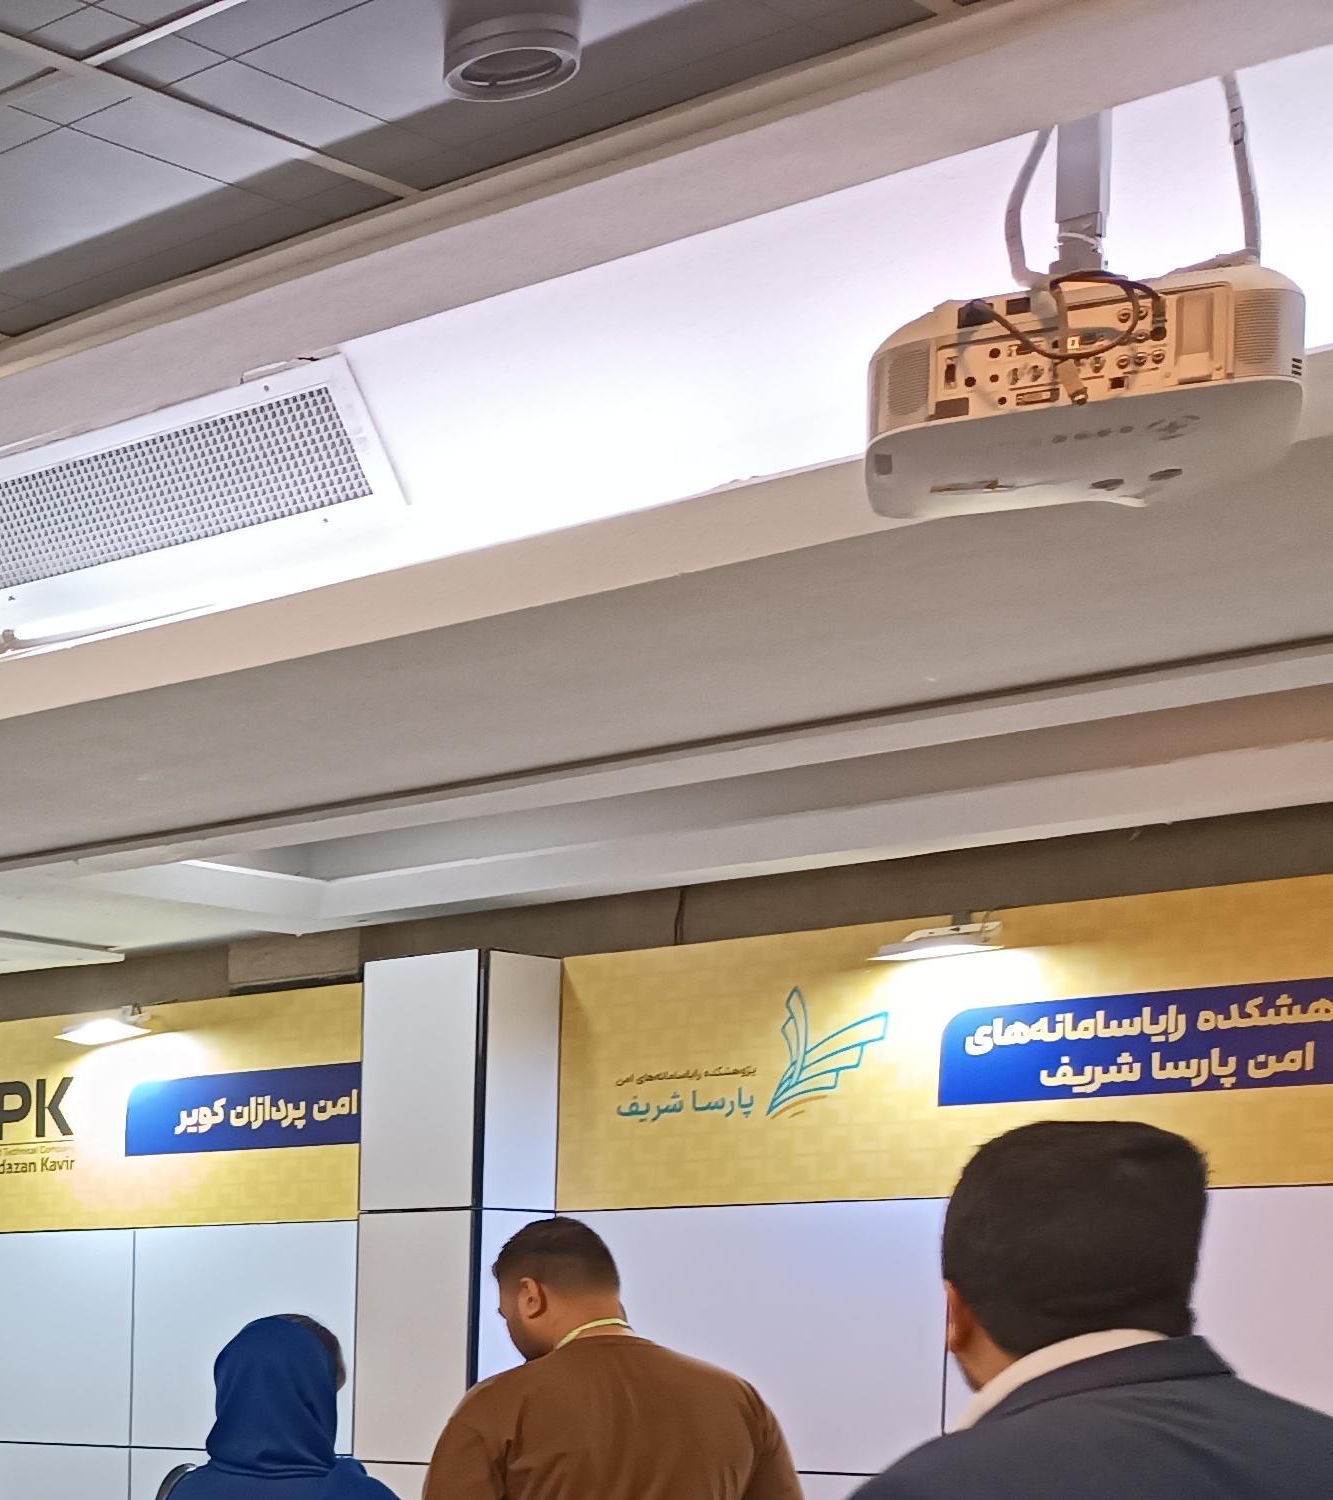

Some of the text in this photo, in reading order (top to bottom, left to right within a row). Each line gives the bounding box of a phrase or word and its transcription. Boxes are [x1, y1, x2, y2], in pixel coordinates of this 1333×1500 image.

[1197, 993, 1333, 1030] هشکده
[1039, 1040, 1315, 1093] امن پارسا شریف
[174, 1089, 358, 1135] امن پردازان کویر
[616, 1087, 755, 1122] پارسا شریف
[41, 1155, 75, 1173] Kavir
